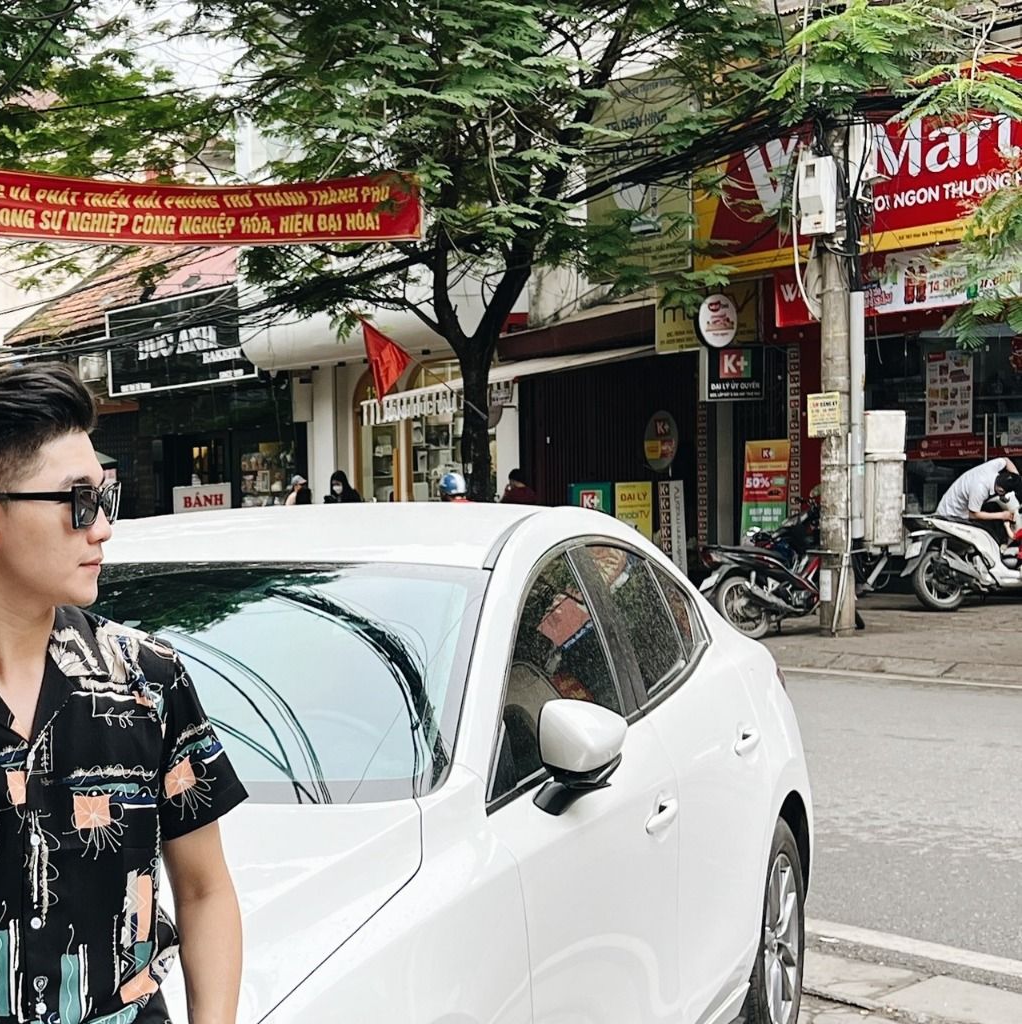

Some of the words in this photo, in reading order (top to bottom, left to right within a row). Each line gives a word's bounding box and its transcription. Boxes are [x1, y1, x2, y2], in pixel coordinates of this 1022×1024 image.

[35, 187, 81, 206] PHÁT
[894, 185, 939, 208] NGON
[38, 208, 66, 234] SỰ
[66, 211, 129, 236] NGHIỆP
[131, 212, 176, 236] CÔNG
[179, 211, 236, 238] NGHIỆP
[279, 212, 314, 237] HIỆN
[316, 213, 342, 235] ĐẠI
[202, 346, 242, 364] BAKERY
[723, 354, 748, 374] K+
[745, 477, 771, 488] 50%
[183, 491, 224, 508] BÁNH
